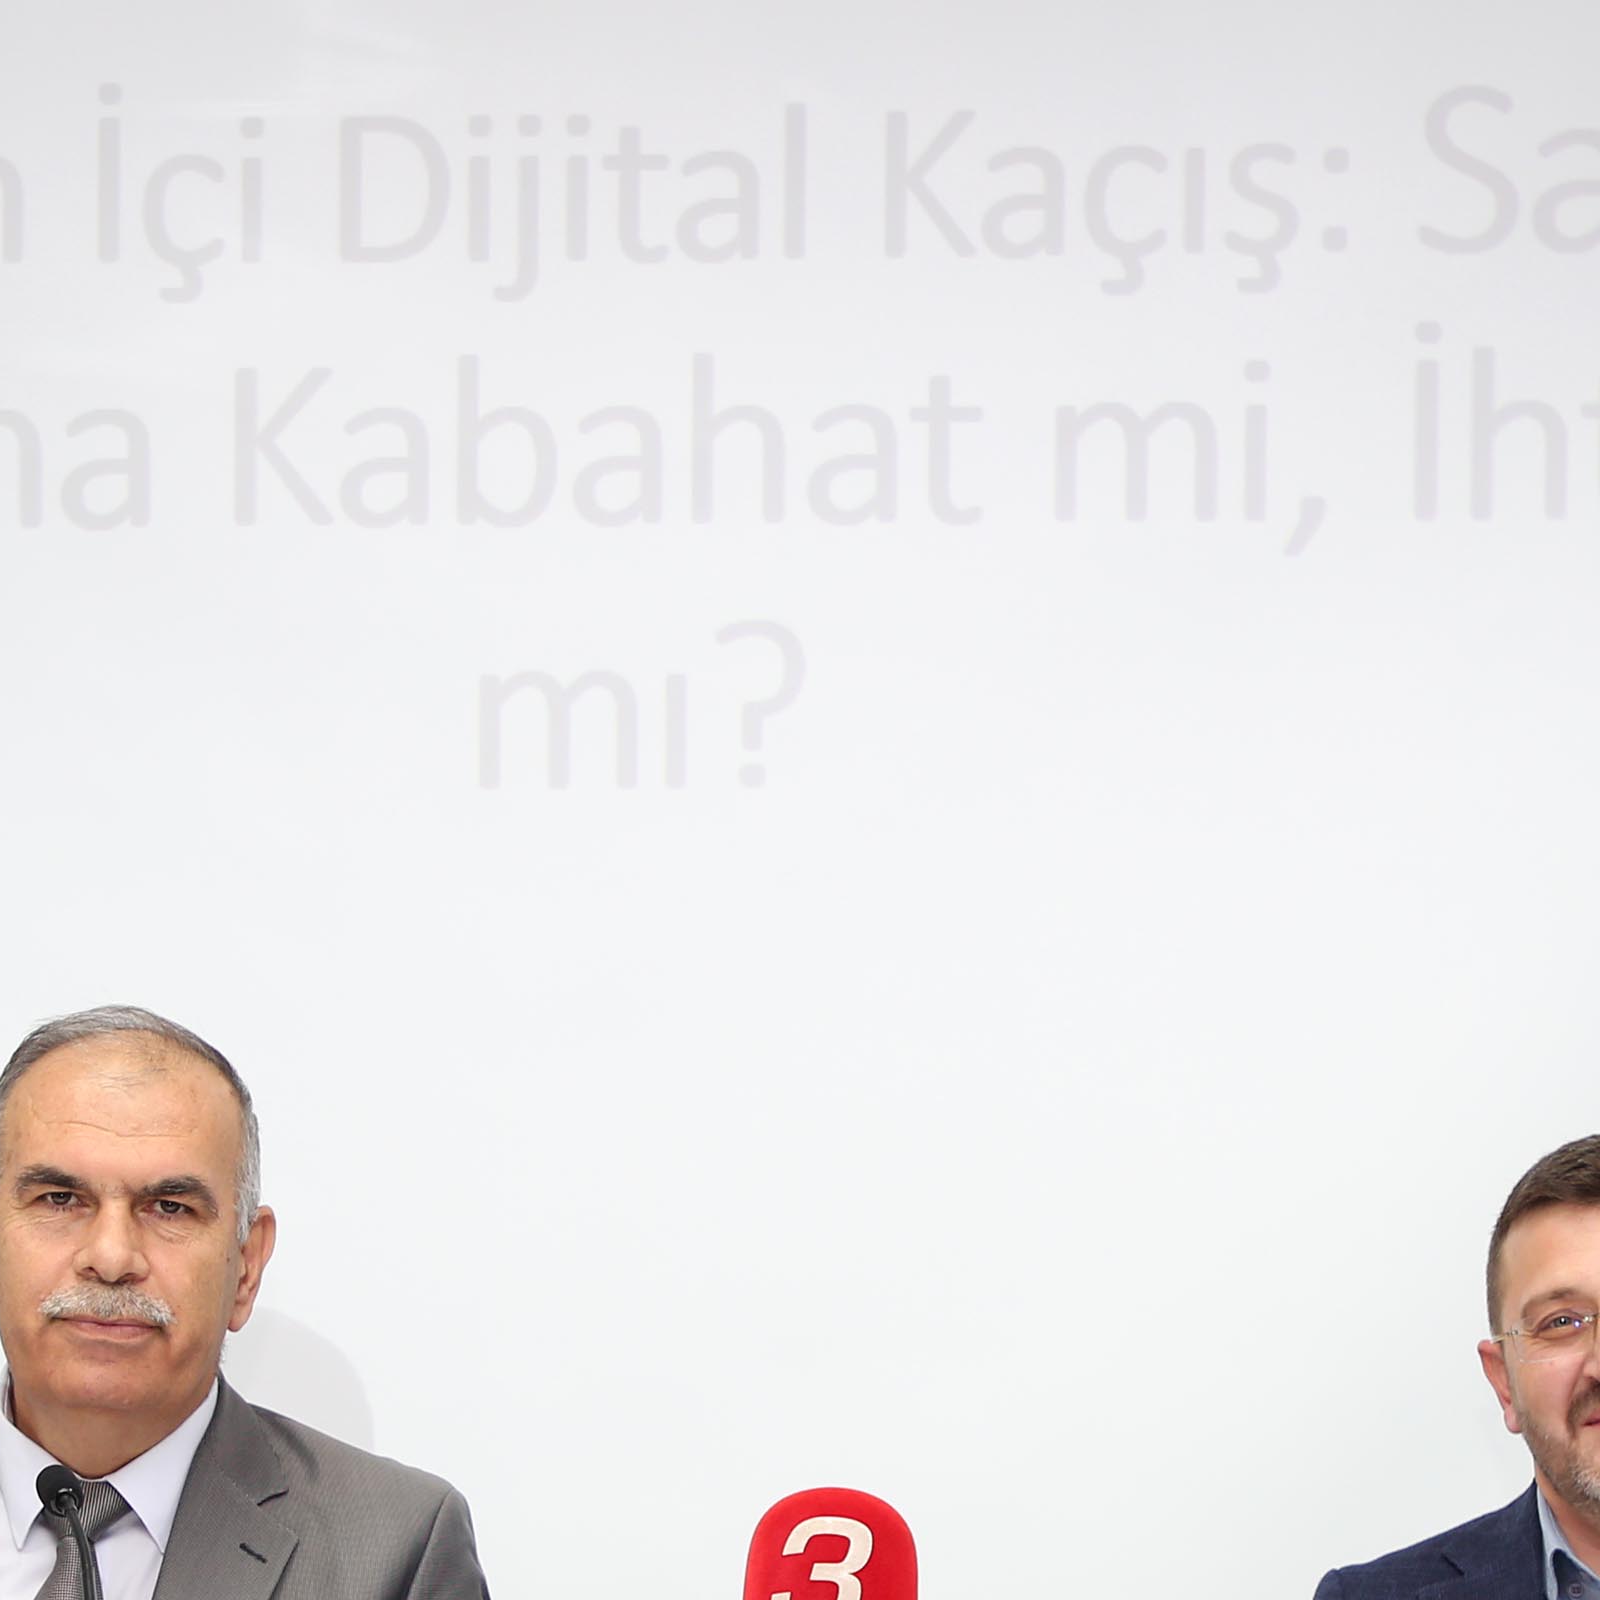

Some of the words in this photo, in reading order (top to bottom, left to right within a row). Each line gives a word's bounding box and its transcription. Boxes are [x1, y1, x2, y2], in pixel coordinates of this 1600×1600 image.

[97, 83, 264, 303] İçi
[338, 103, 807, 303] Dijital
[883, 110, 1350, 295] Kaçış:
[233, 353, 984, 529] Kabahat
[1053, 359, 1327, 556] mi,
[478, 620, 807, 790] mı?
